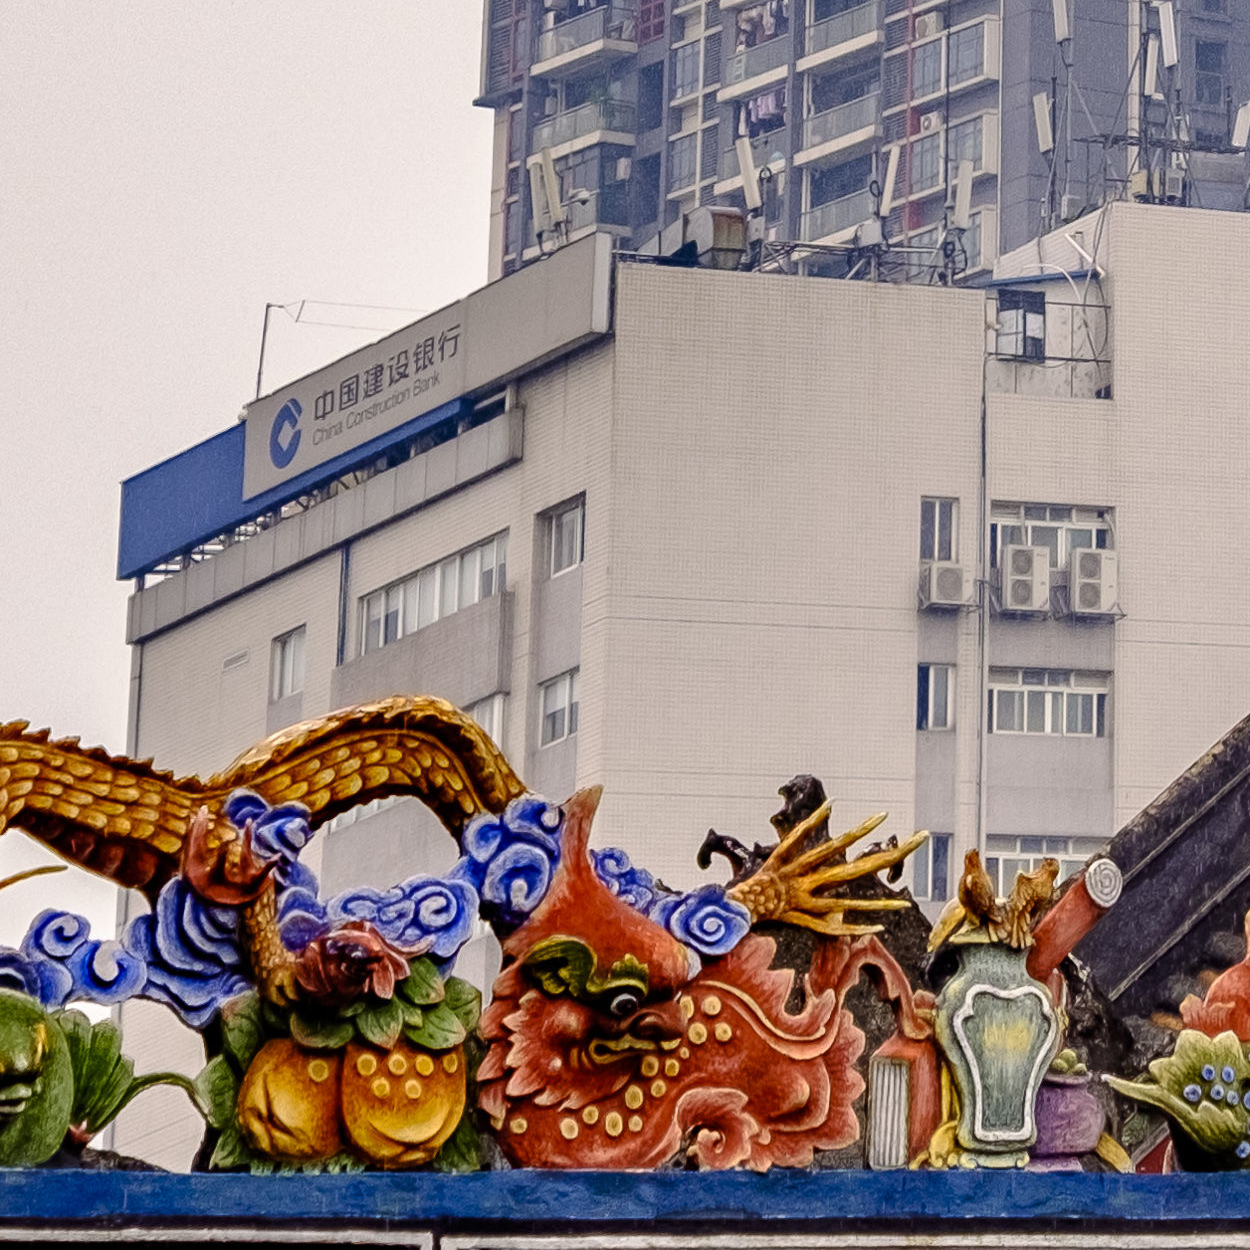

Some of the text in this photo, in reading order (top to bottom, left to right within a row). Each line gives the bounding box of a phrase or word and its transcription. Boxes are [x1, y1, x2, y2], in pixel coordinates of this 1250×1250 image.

[312, 371, 440, 446] China Construction Bank
[314, 324, 461, 421] 中国建设银行
